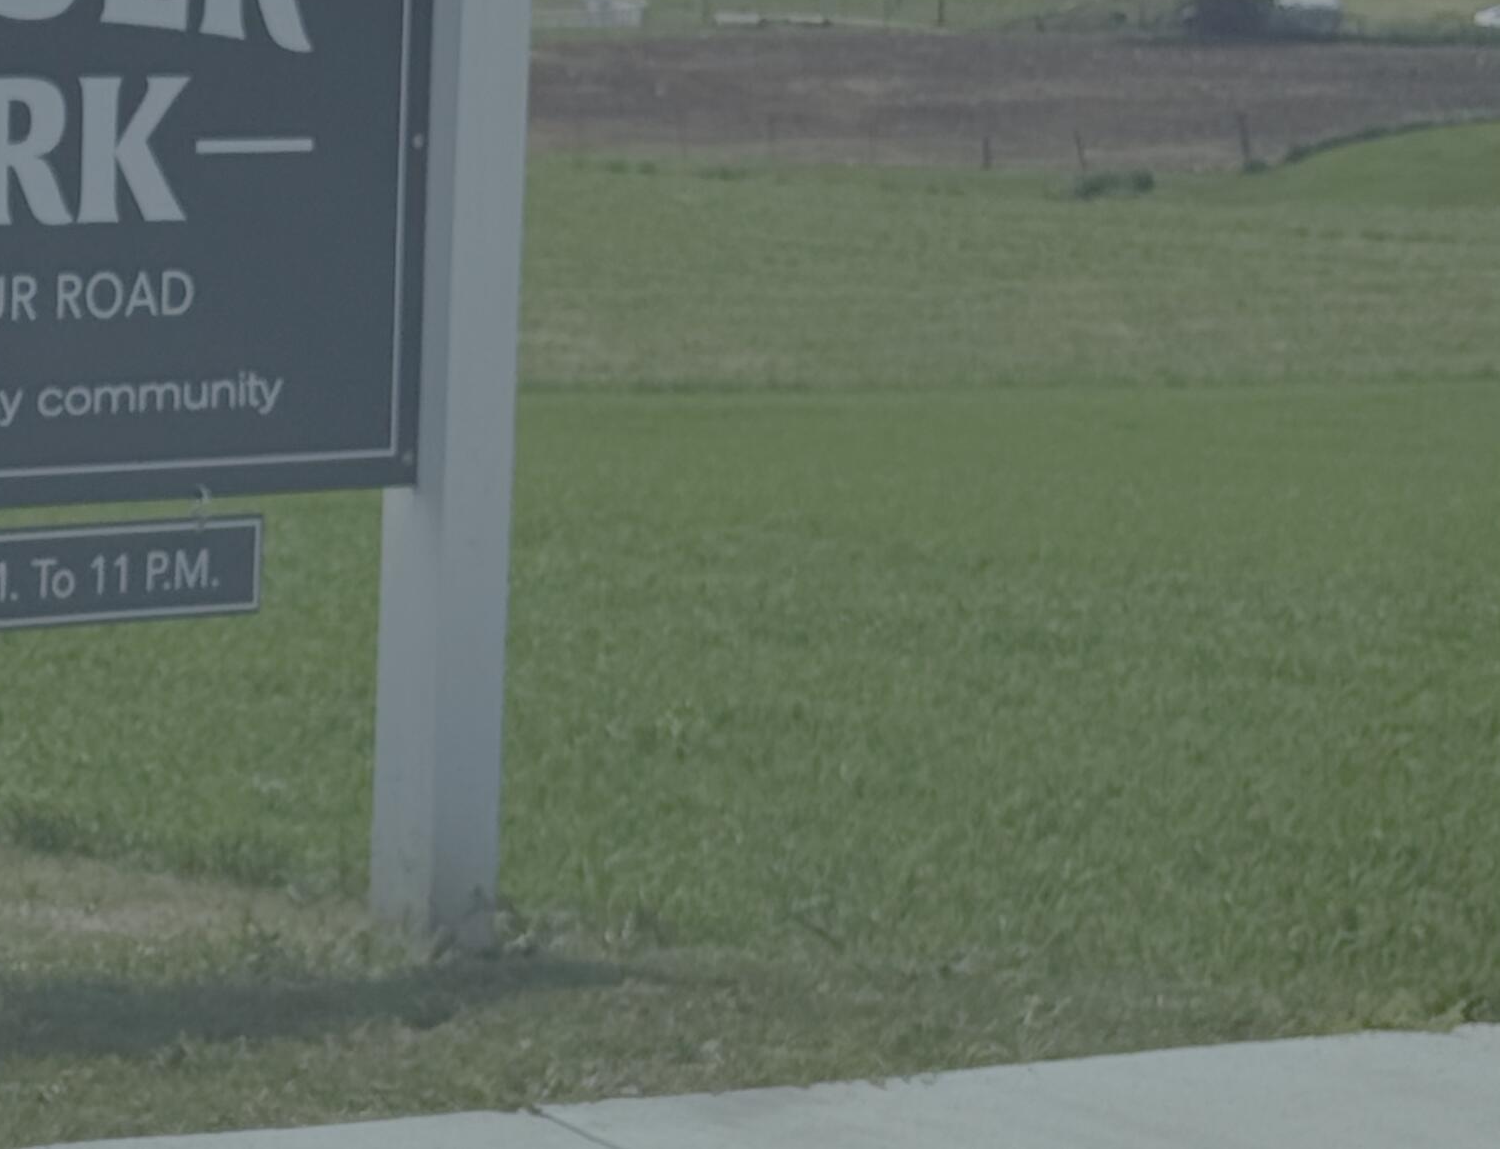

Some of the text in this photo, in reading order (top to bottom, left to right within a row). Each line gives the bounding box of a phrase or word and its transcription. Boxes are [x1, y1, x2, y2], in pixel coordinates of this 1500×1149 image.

[56, 269, 195, 320] ROAD
[36, 370, 284, 418] community
[32, 557, 77, 600] To
[91, 552, 132, 595] 11
[146, 547, 220, 591] P.M.
